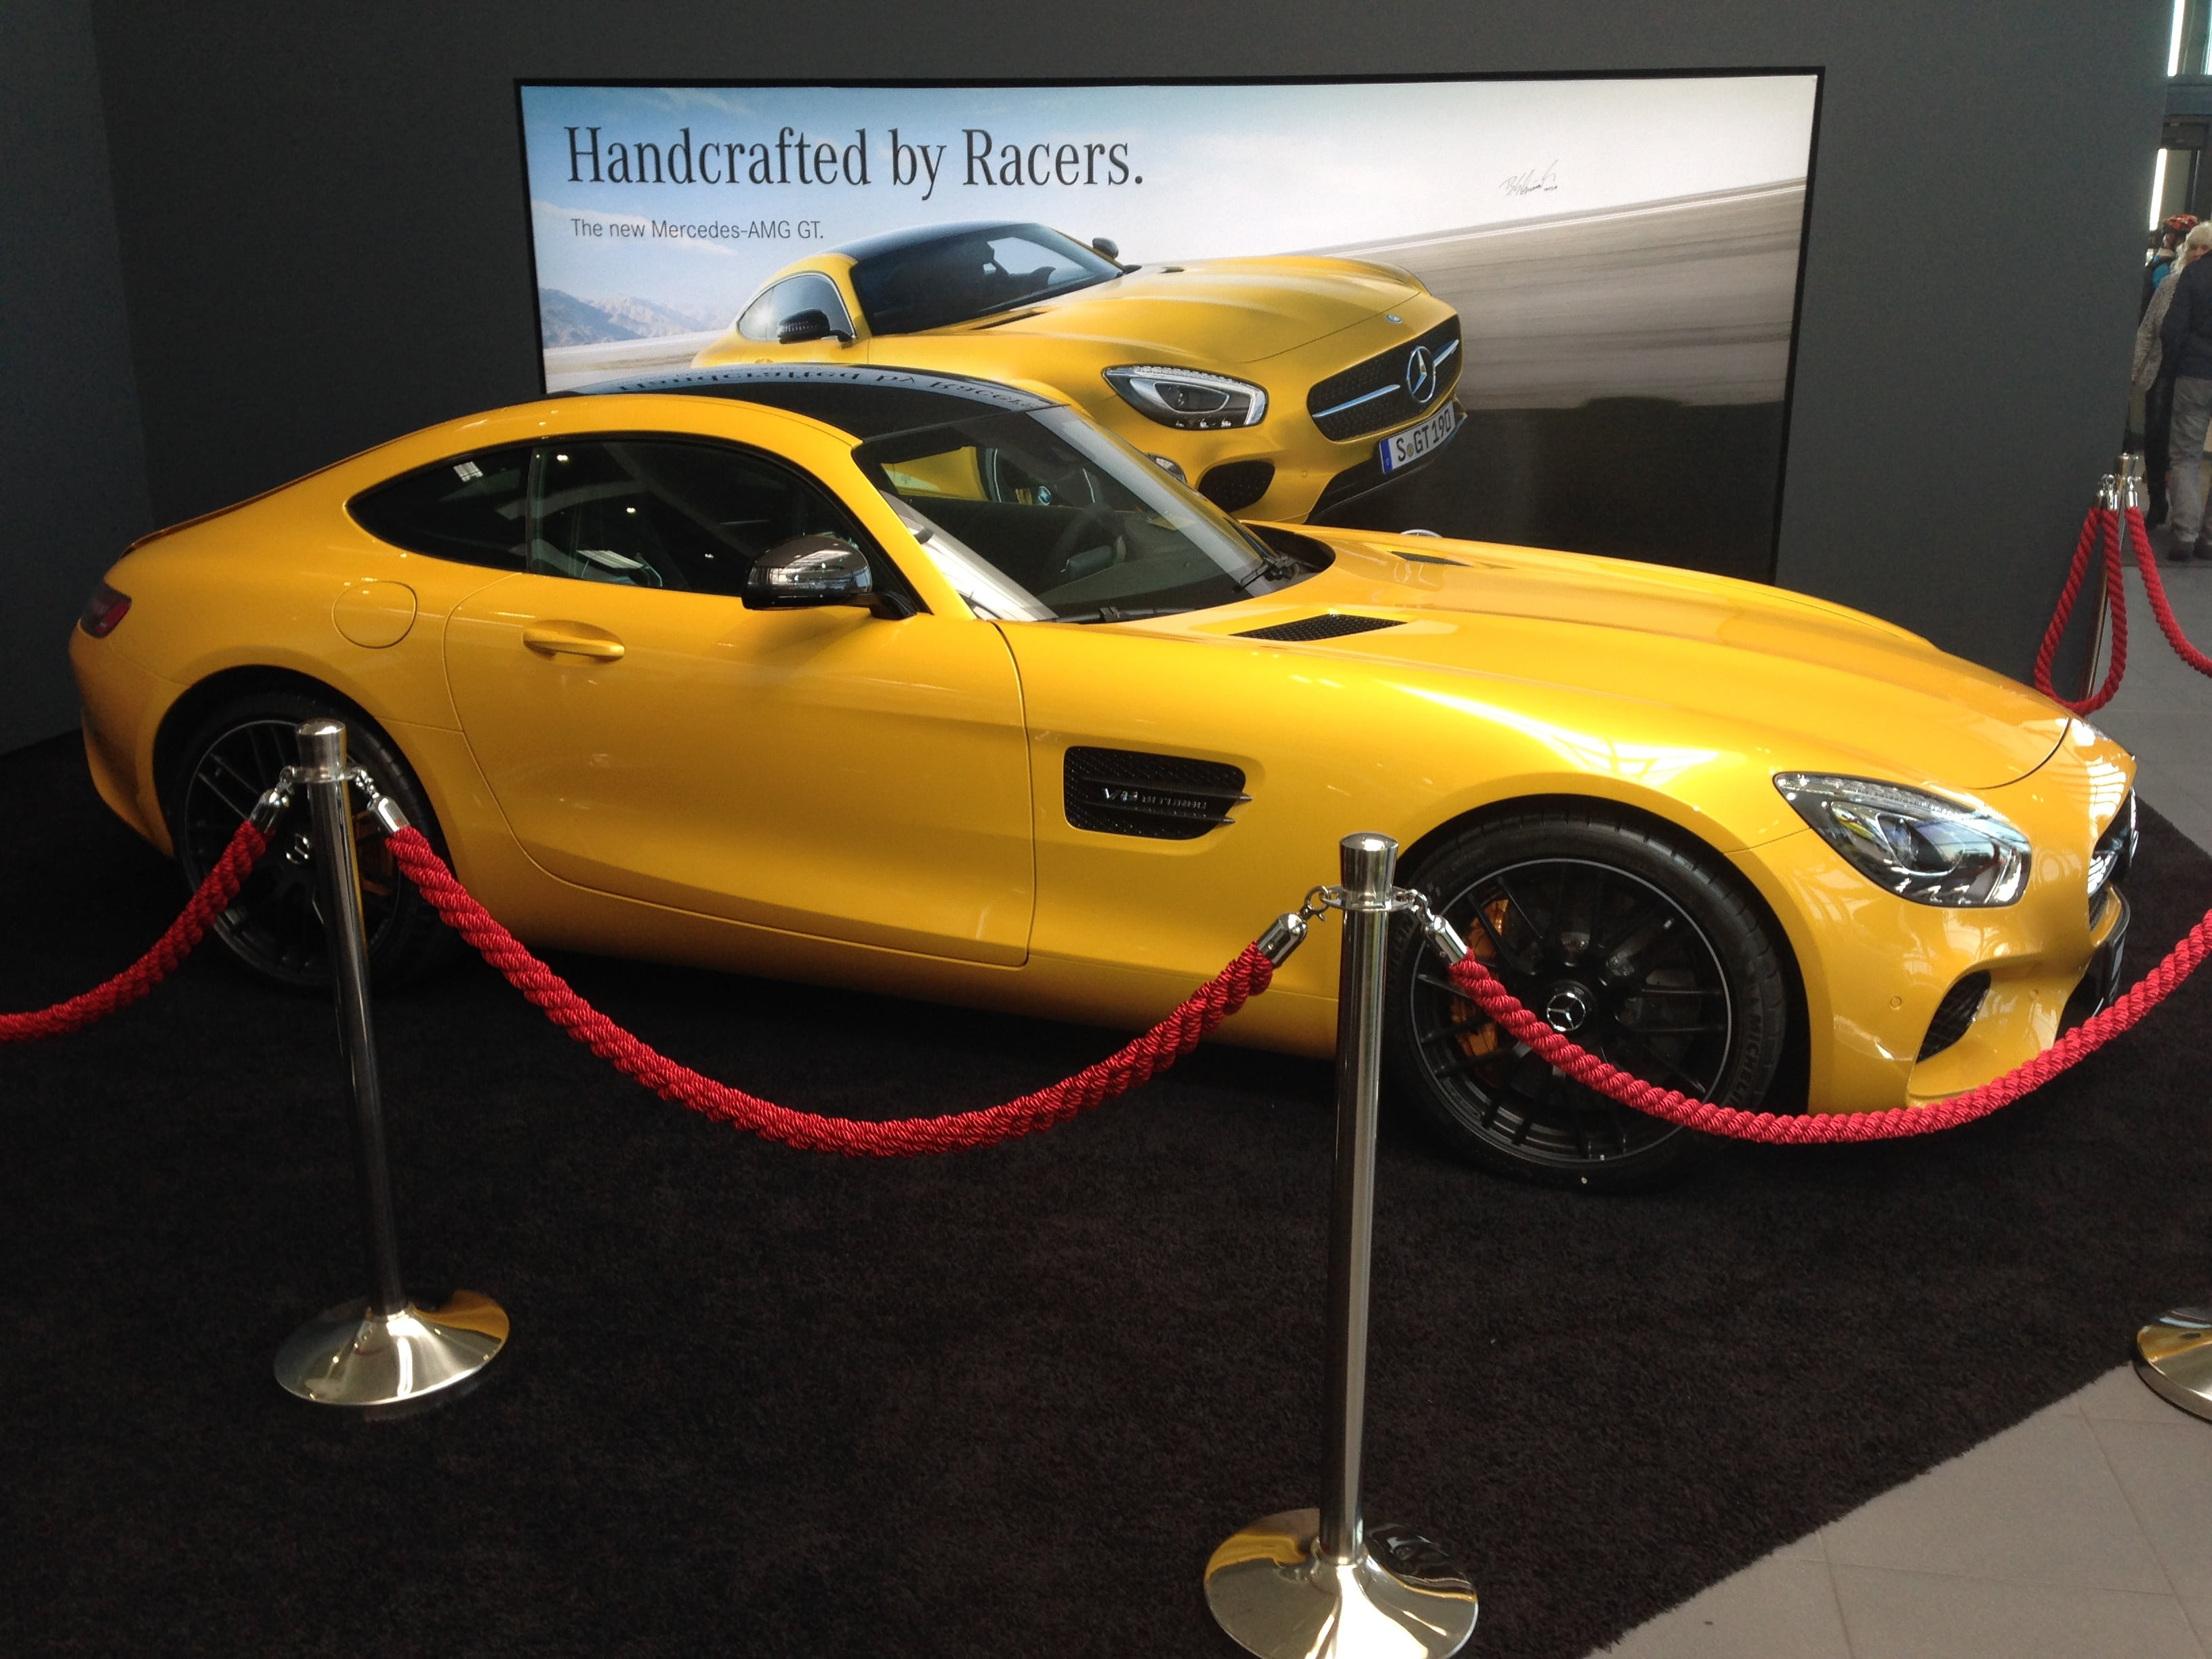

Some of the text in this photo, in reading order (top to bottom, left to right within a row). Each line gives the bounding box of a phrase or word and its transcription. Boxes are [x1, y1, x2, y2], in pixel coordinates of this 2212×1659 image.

[565, 126, 1144, 201] Handcrafted by Racers.
[571, 218, 823, 239] The new Mercedes-AMG GT.
[1396, 438, 1406, 462] S
